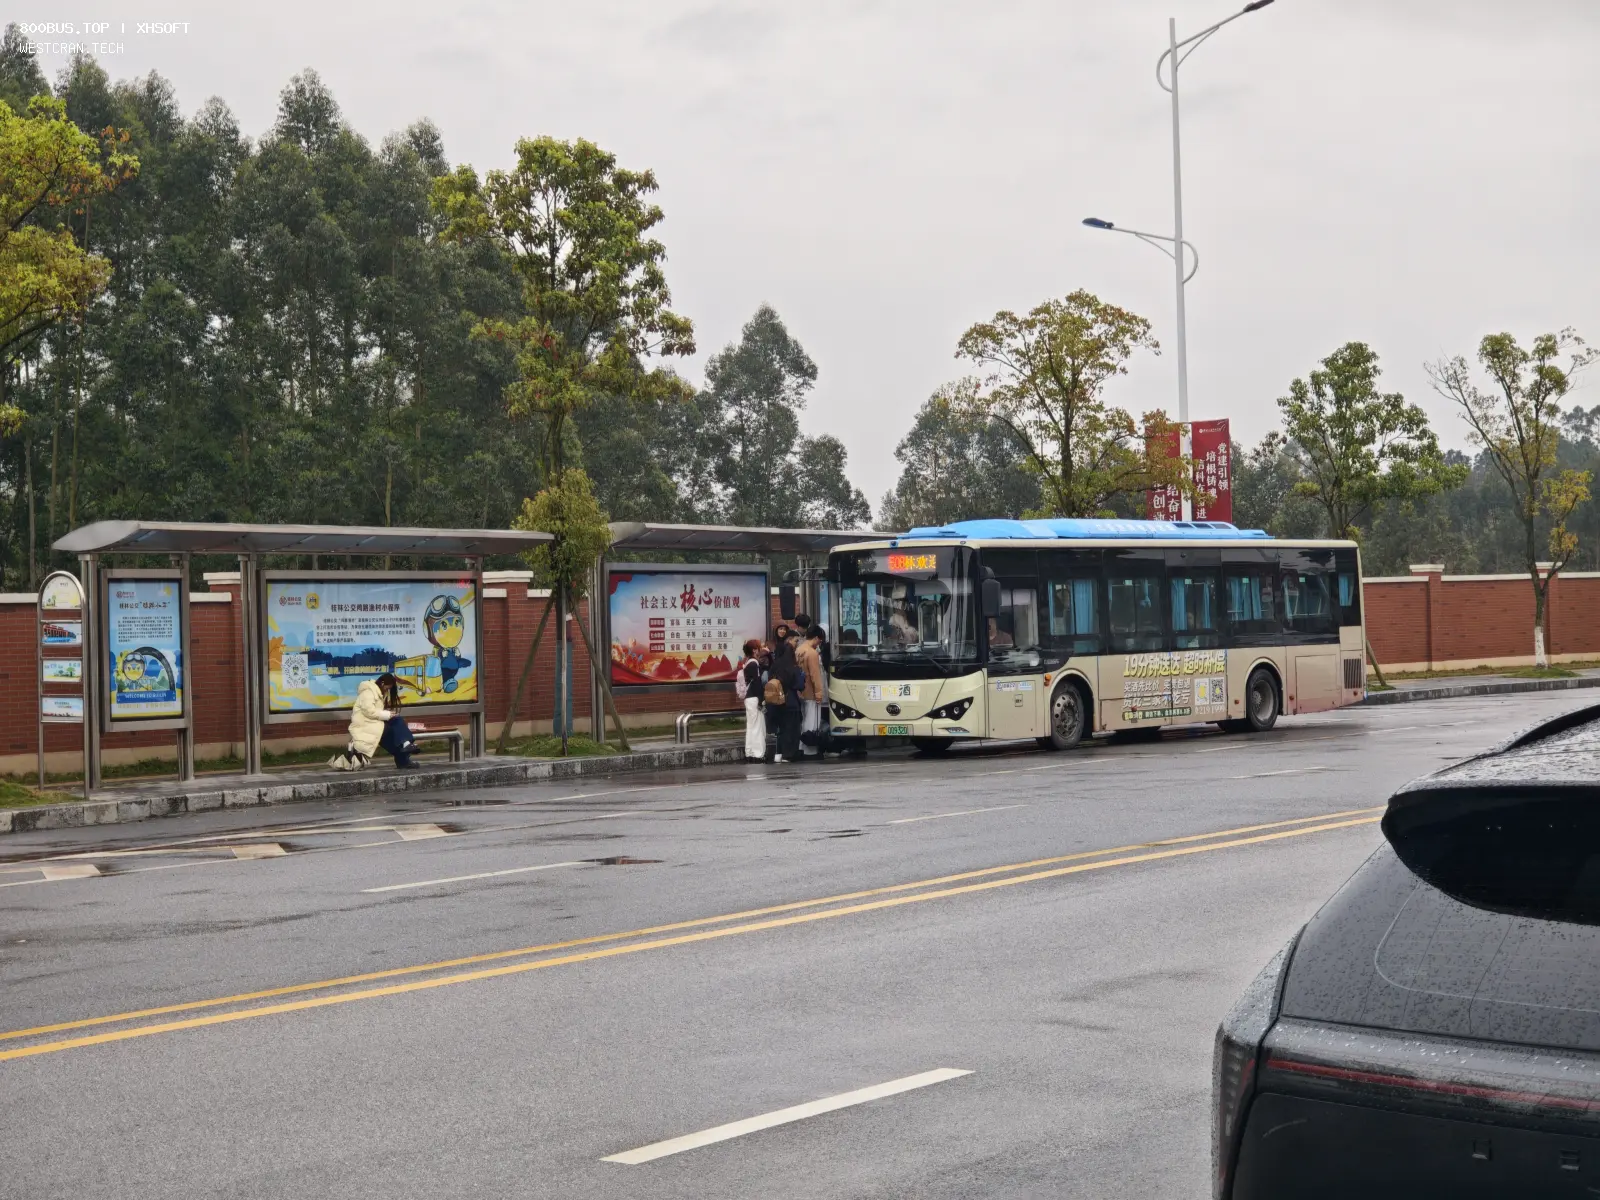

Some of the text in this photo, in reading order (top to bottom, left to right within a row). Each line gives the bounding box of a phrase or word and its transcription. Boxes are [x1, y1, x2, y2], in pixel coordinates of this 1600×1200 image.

[1217, 442, 1229, 491] 党建引领
[641, 583, 740, 613] 社会主义核心价值观
[686, 618, 696, 626] 民主
[702, 618, 712, 626] 文明
[670, 631, 681, 639] 自由
[702, 630, 712, 638] 公正
[1123, 649, 1226, 678] 19分钟送达 超时补偿
[1123, 680, 1160, 693] 买酒先比价
